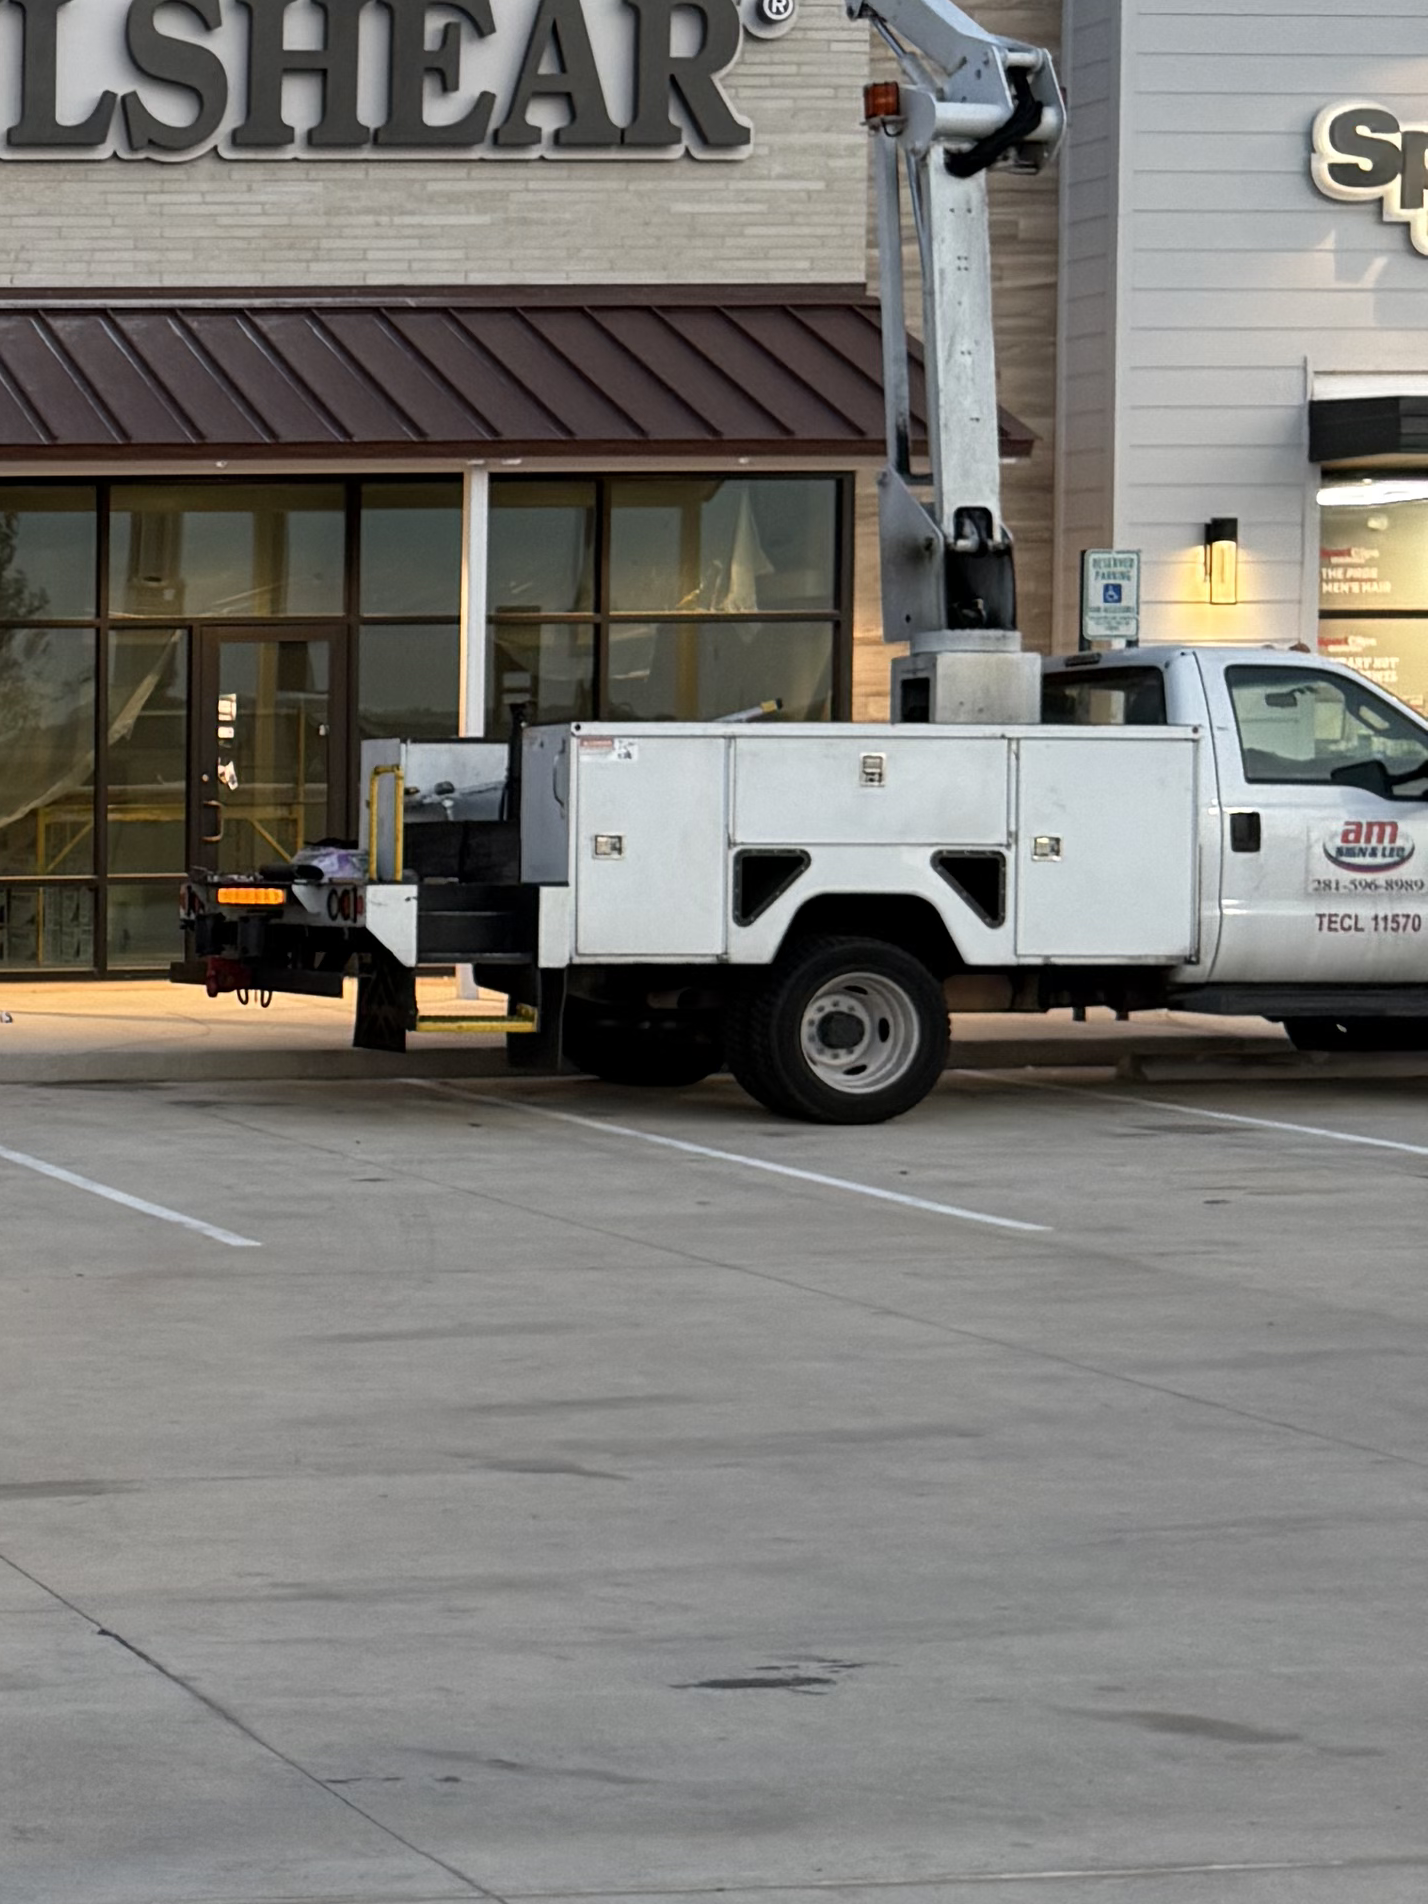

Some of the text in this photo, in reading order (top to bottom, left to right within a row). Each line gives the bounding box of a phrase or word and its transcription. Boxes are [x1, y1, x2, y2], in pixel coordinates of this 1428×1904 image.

[1094, 570, 1131, 582] PARKING
[1340, 821, 1399, 845] am
[1312, 878, 1425, 892] 281-596-8989
[1315, 913, 1422, 932] TECL 11570
